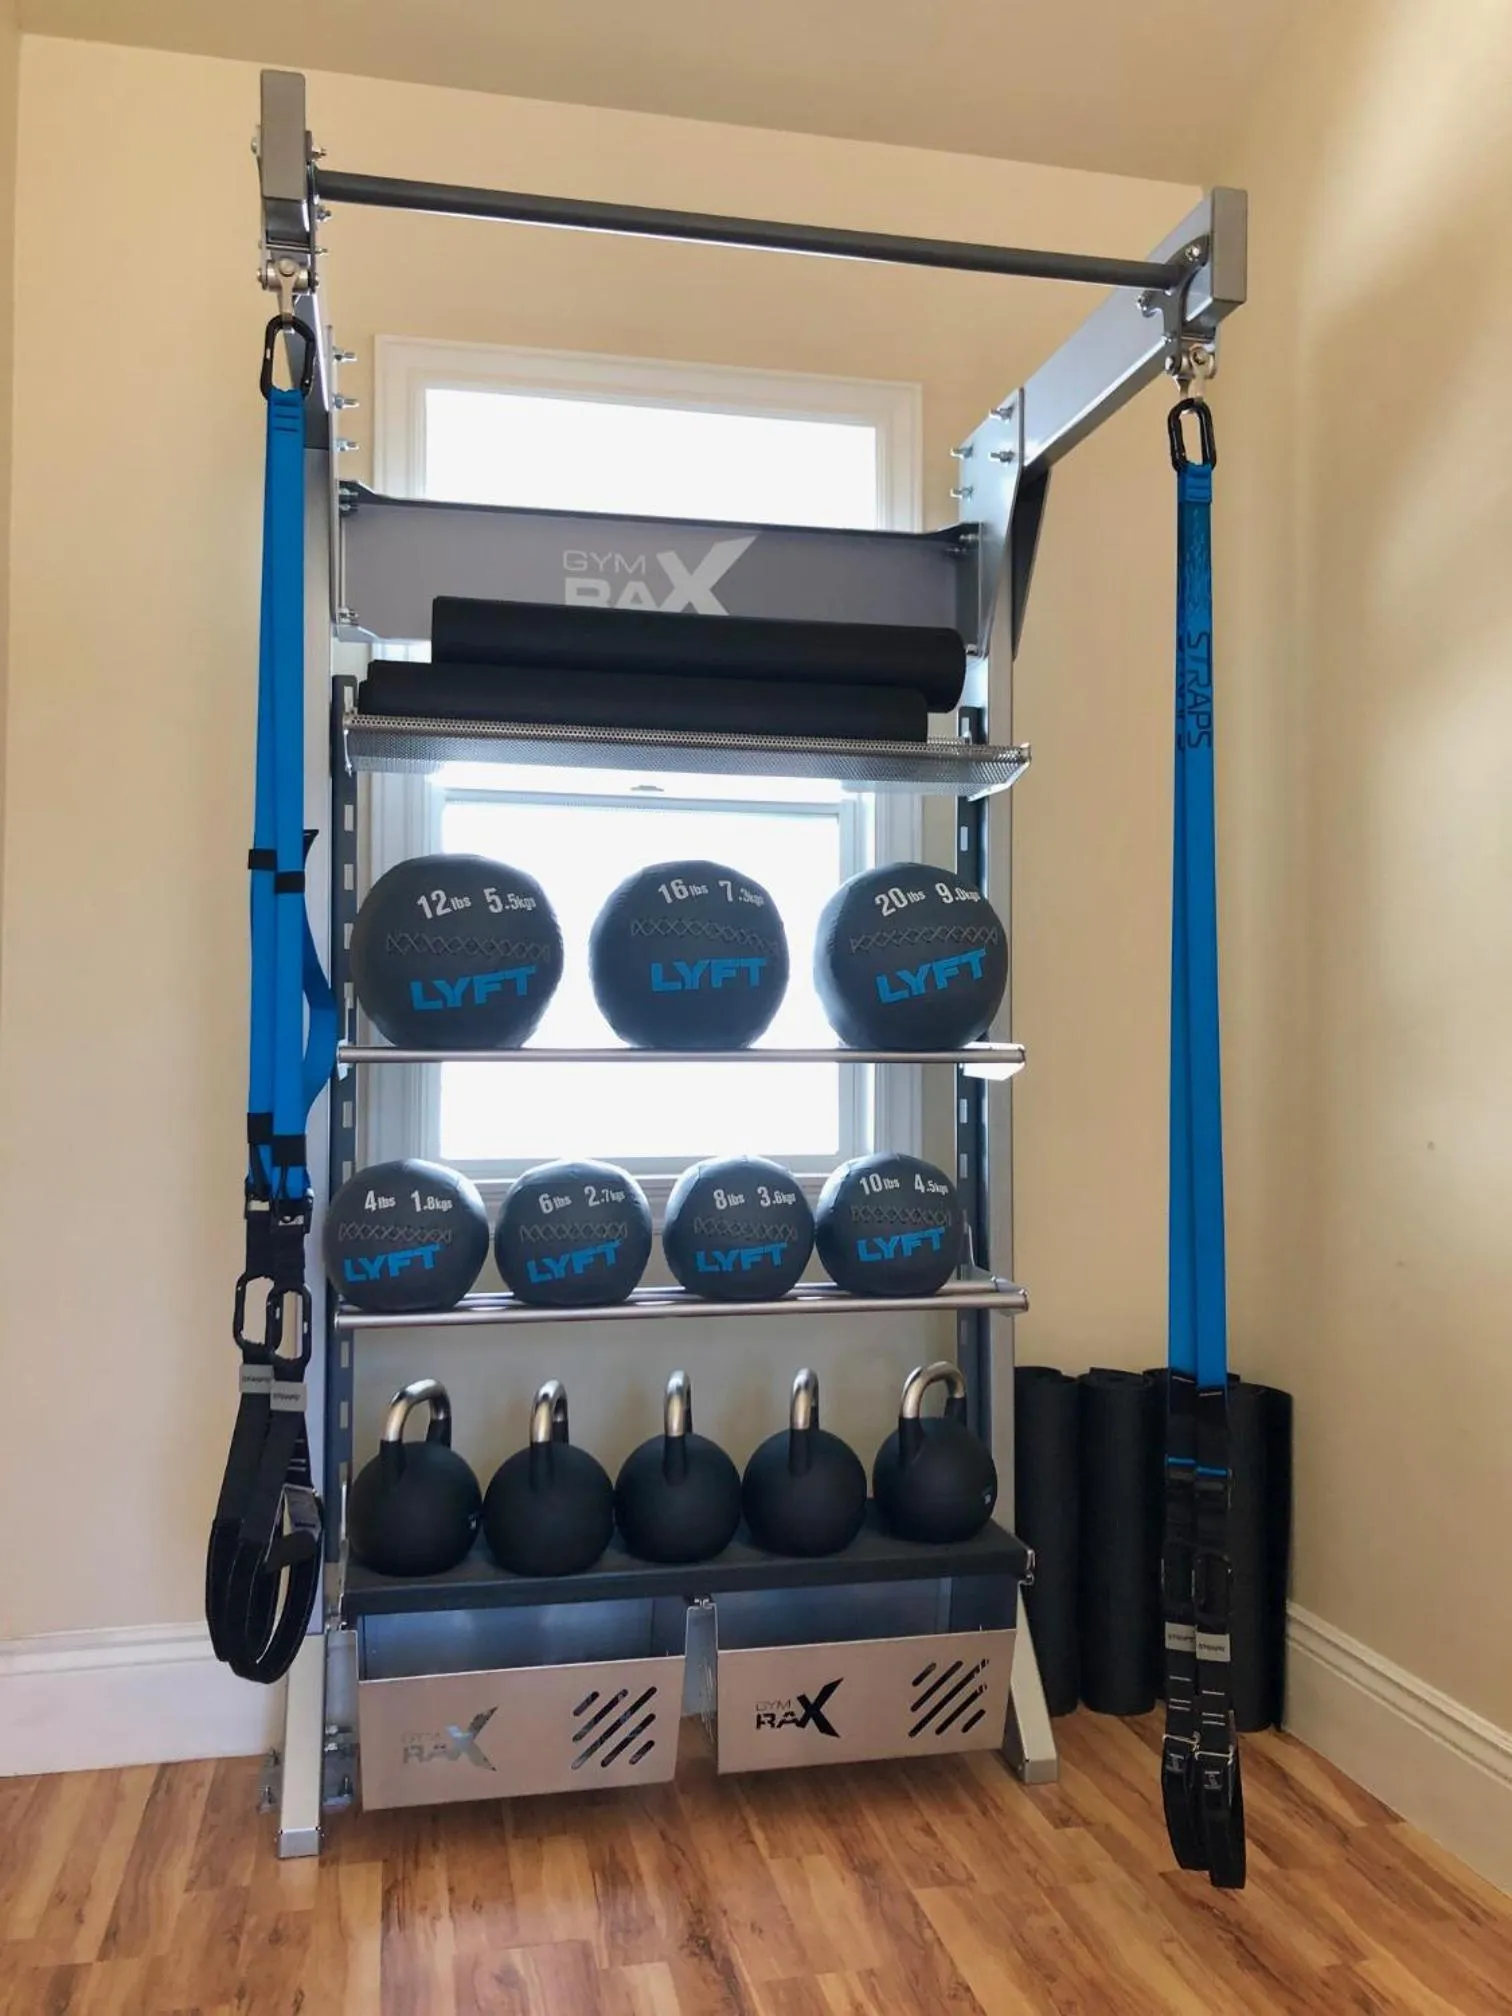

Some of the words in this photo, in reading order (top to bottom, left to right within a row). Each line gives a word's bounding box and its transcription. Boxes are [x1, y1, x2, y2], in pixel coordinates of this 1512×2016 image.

[563, 550, 647, 575] GYM
[409, 964, 537, 1010] LYFT
[650, 957, 767, 992] LYFT
[876, 947, 986, 1003] LYFT
[344, 1243, 441, 1282] LYFT
[526, 1239, 622, 1284] LYFT
[696, 1241, 788, 1273] LYFT
[857, 1226, 946, 1262] LYFT
